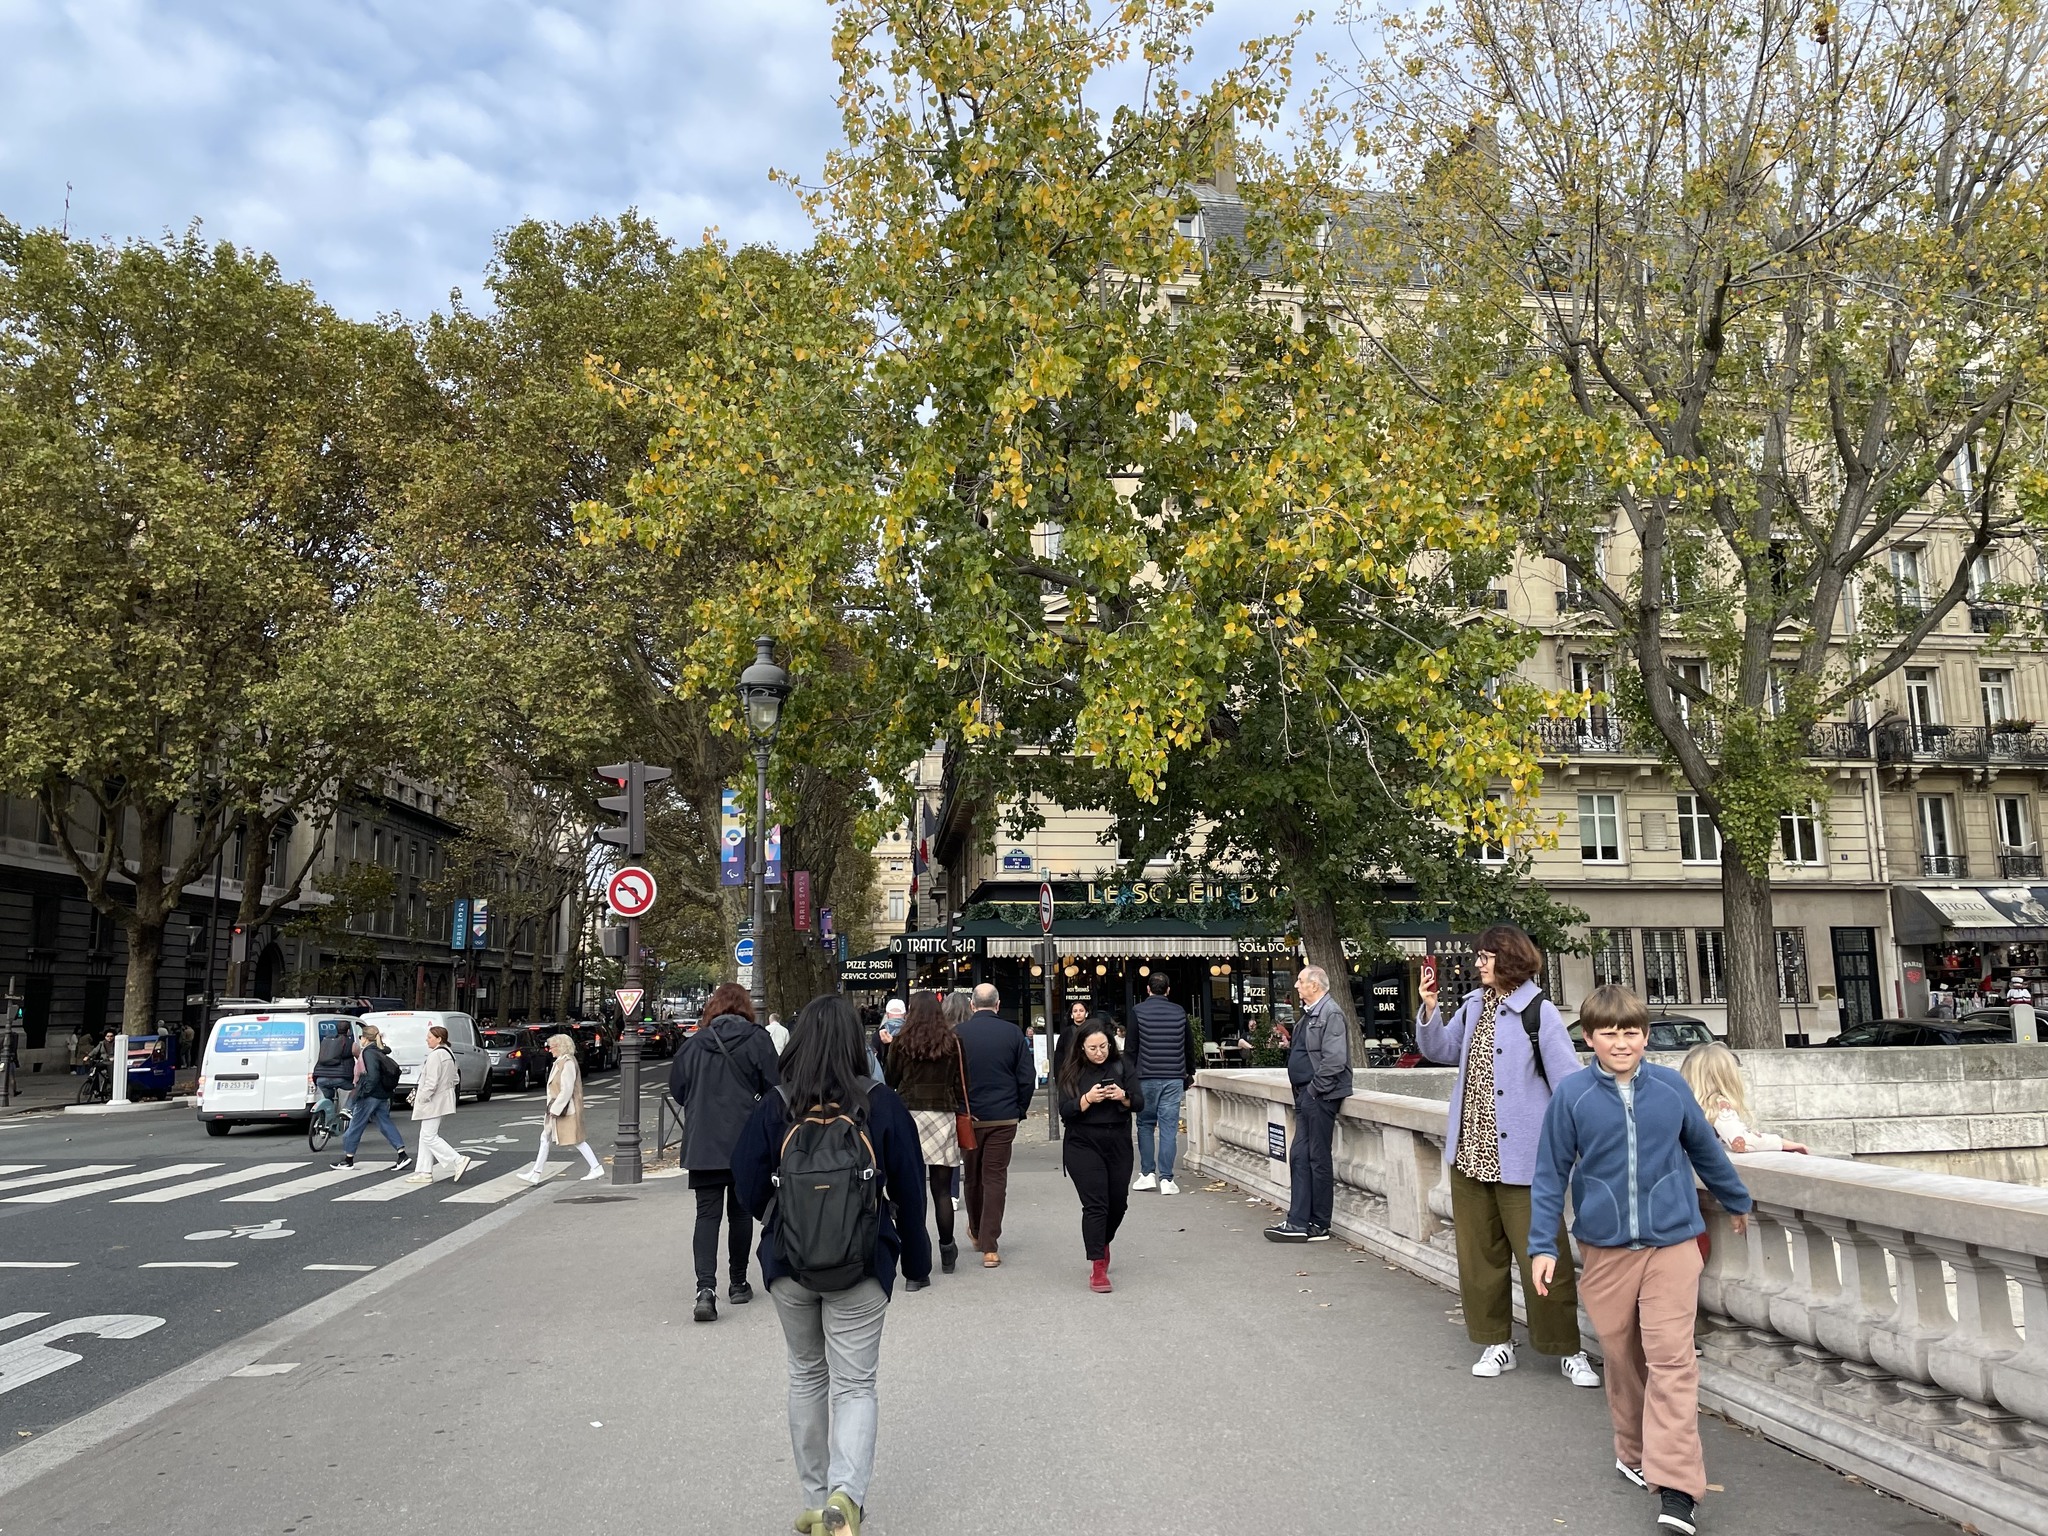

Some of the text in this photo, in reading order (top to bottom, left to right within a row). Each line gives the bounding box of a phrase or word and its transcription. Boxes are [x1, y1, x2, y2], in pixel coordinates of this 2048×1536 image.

[1088, 882, 1119, 904] LE
[1935, 902, 1987, 911] PHOTO
[455, 903, 465, 946] PARIS 2024
[846, 960, 894, 970] PIZZE PASTA
[1903, 961, 1923, 969] PARIS
[841, 972, 897, 980] SERVICE CONTINU
[1245, 987, 1266, 997] PIZZE
[1373, 986, 1399, 996] COFFEE
[1242, 1004, 1270, 1014] PASTA
[1378, 1002, 1396, 1012] BAR
[224, 1024, 263, 1033] DD
[320, 1023, 336, 1031] DD
